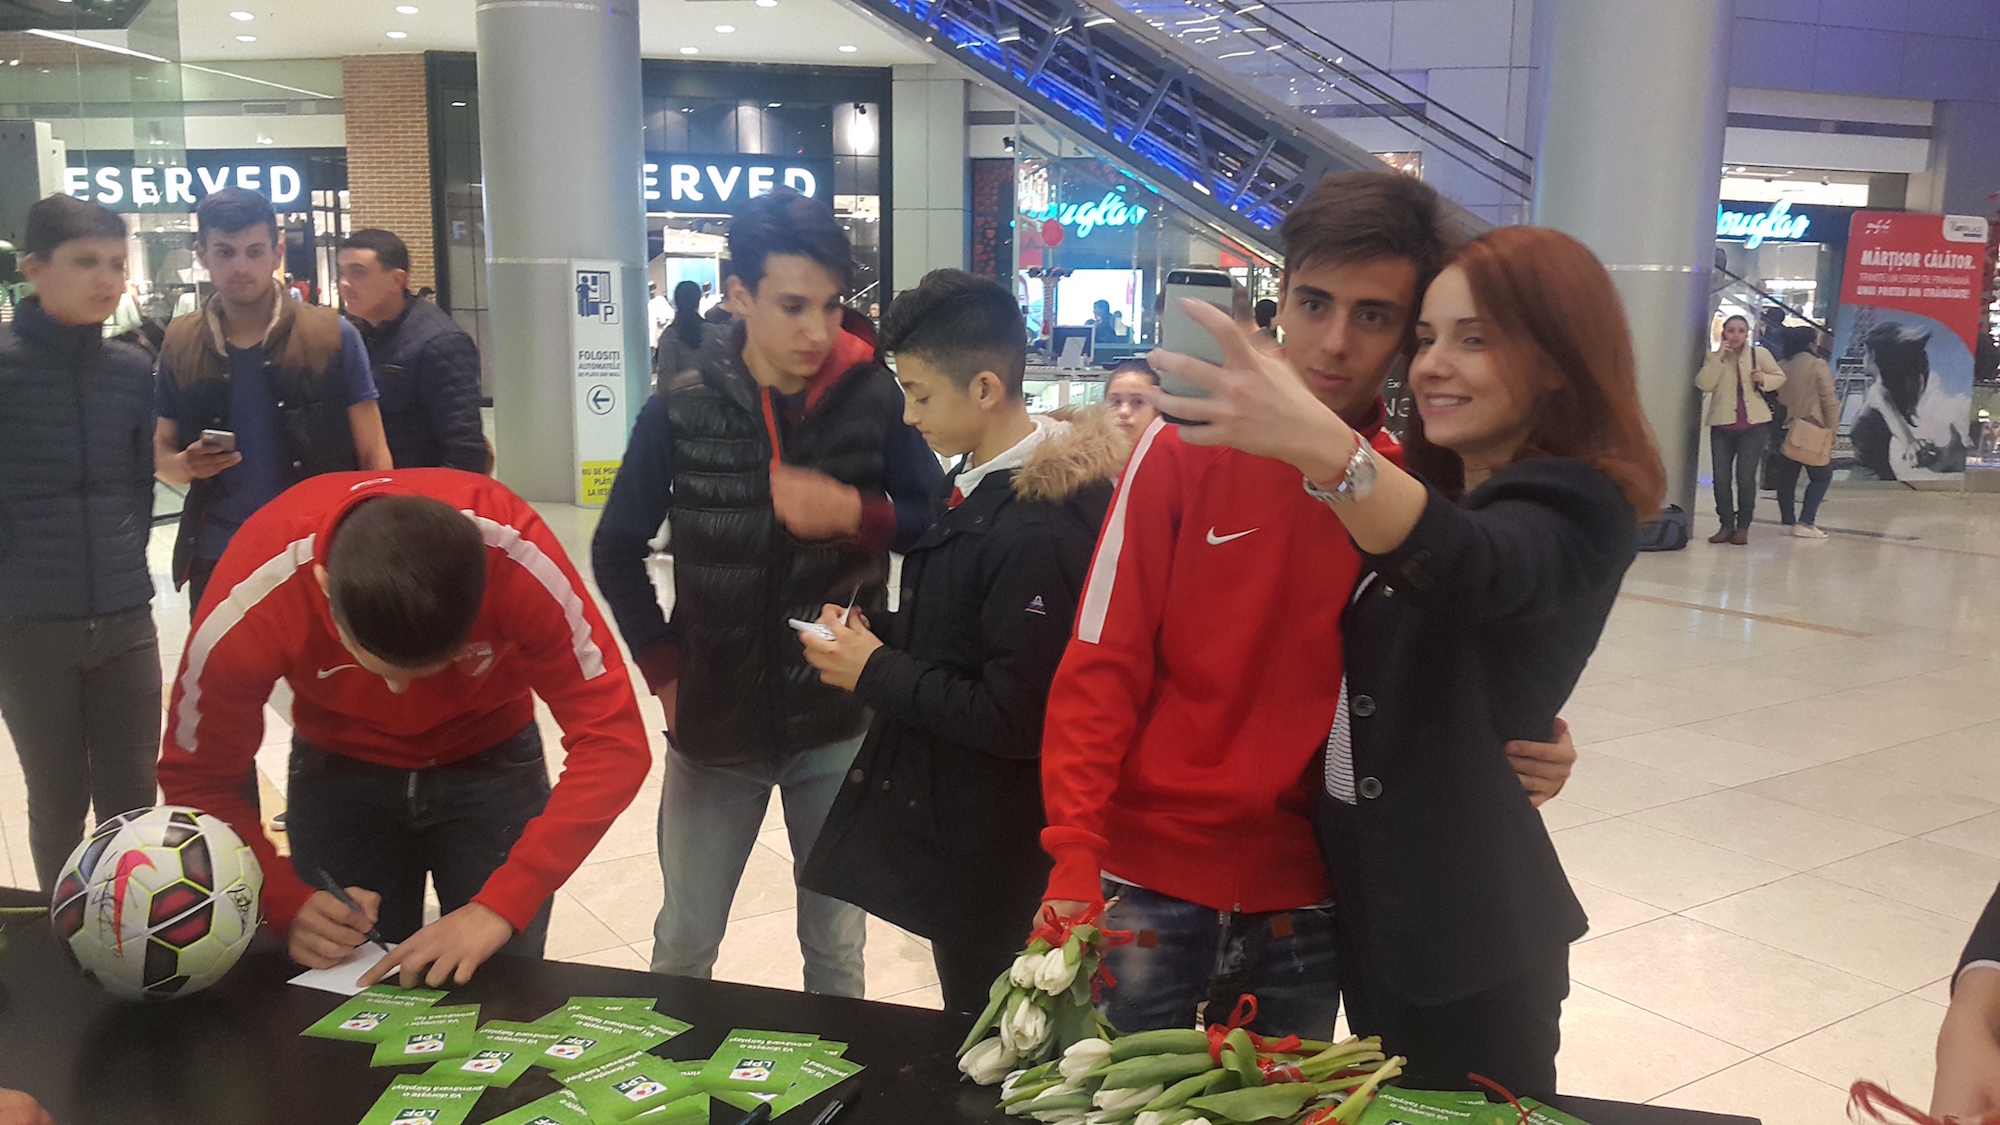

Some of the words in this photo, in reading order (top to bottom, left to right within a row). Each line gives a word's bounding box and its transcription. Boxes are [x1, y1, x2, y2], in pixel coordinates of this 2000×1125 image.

[643, 163, 816, 202] ERVED
[1716, 199, 1811, 249] ouglas
[411, 1033, 443, 1042] LPF
